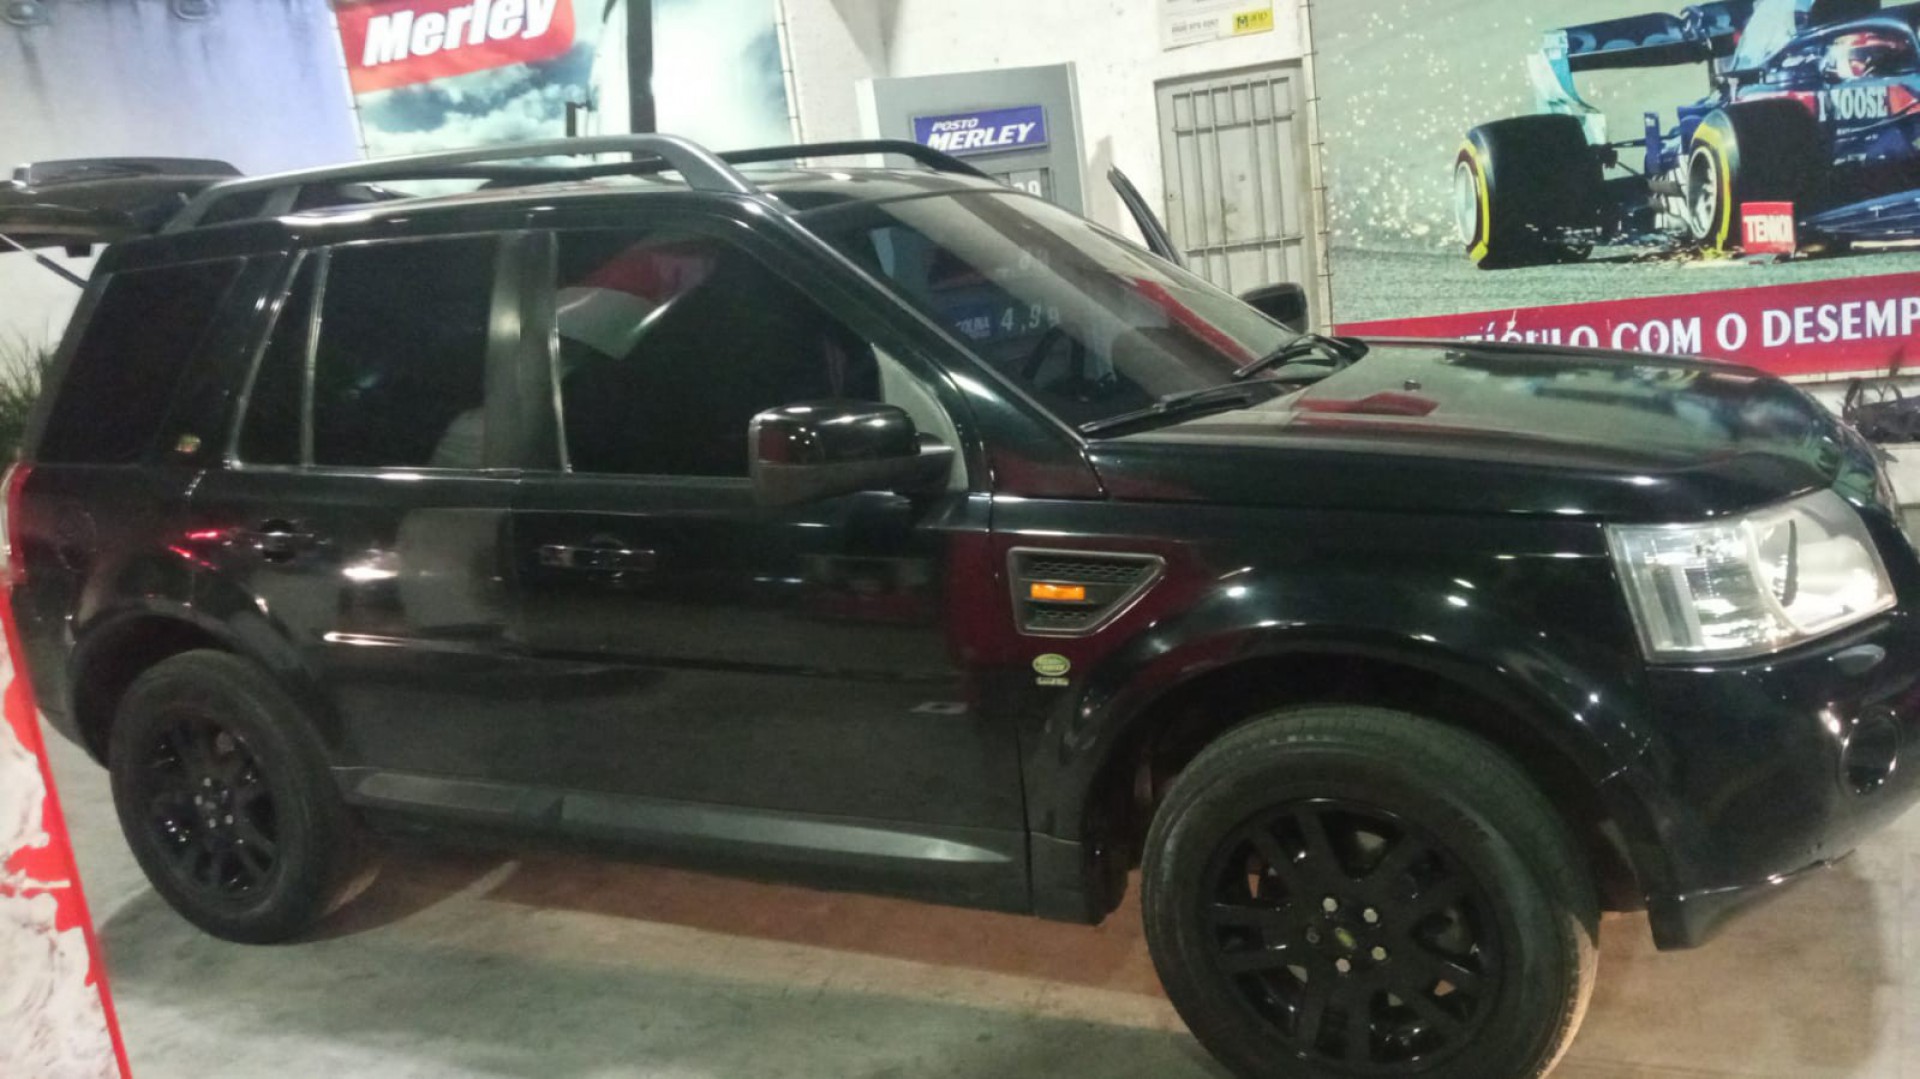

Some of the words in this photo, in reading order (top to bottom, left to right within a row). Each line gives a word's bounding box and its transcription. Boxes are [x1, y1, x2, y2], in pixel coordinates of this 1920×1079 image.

[362, 0, 557, 67] Merley
[926, 122, 1036, 151] MERLEY
[931, 117, 979, 132] POSTO
[1611, 318, 1701, 354] COM
[1716, 312, 1748, 352] O
